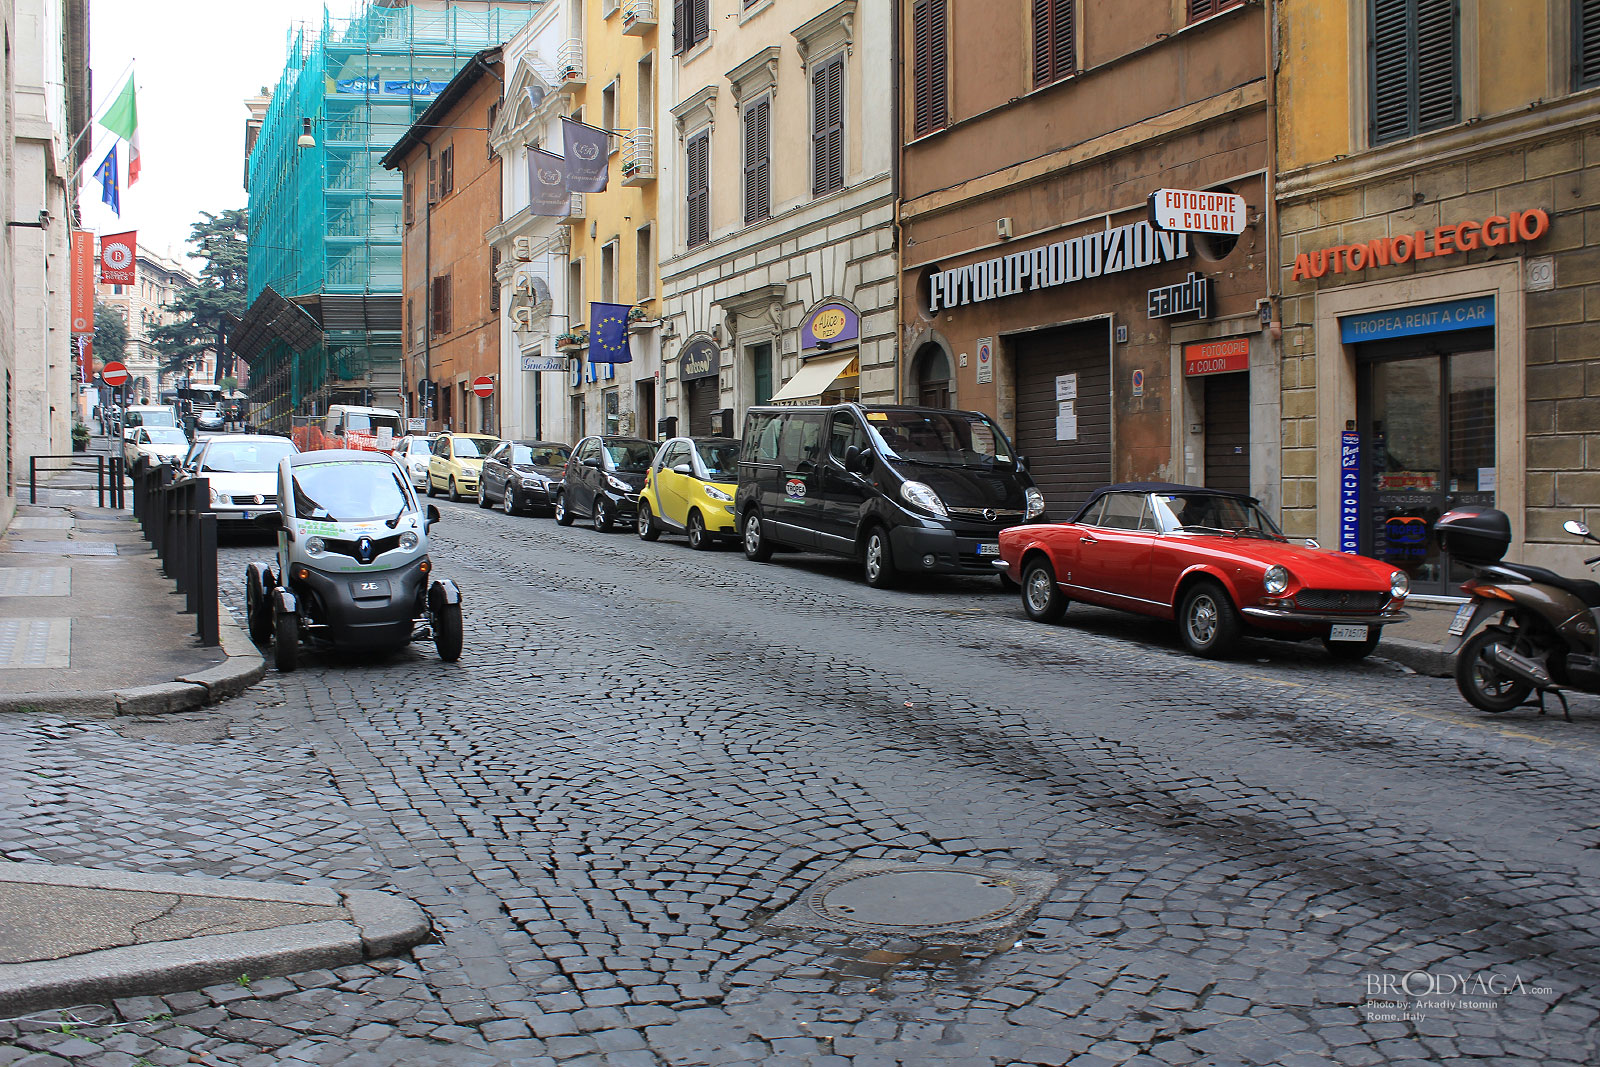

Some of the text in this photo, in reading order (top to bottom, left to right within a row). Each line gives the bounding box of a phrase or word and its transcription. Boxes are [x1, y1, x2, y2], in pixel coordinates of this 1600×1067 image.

[1165, 191, 1236, 213] FOTOCOPIE
[1169, 212, 1235, 231] A COLORI
[1291, 208, 1549, 281] AUTONOLEGGIO
[929, 220, 1190, 312] FOTORIPRODUZIONI
[1531, 264, 1550, 282] 60
[1147, 271, 1207, 320] sandy
[818, 314, 838, 330] Alice
[1353, 305, 1486, 335] TROPEA RENT A CAR
[1201, 341, 1246, 357] FOTOCOPIE
[543, 357, 562, 370] Bar
[1188, 359, 1226, 373] A COLORI
[1342, 457, 1356, 467] Car
[408, 518, 417, 528] 2
[1385, 525, 1426, 535] TROPEA
